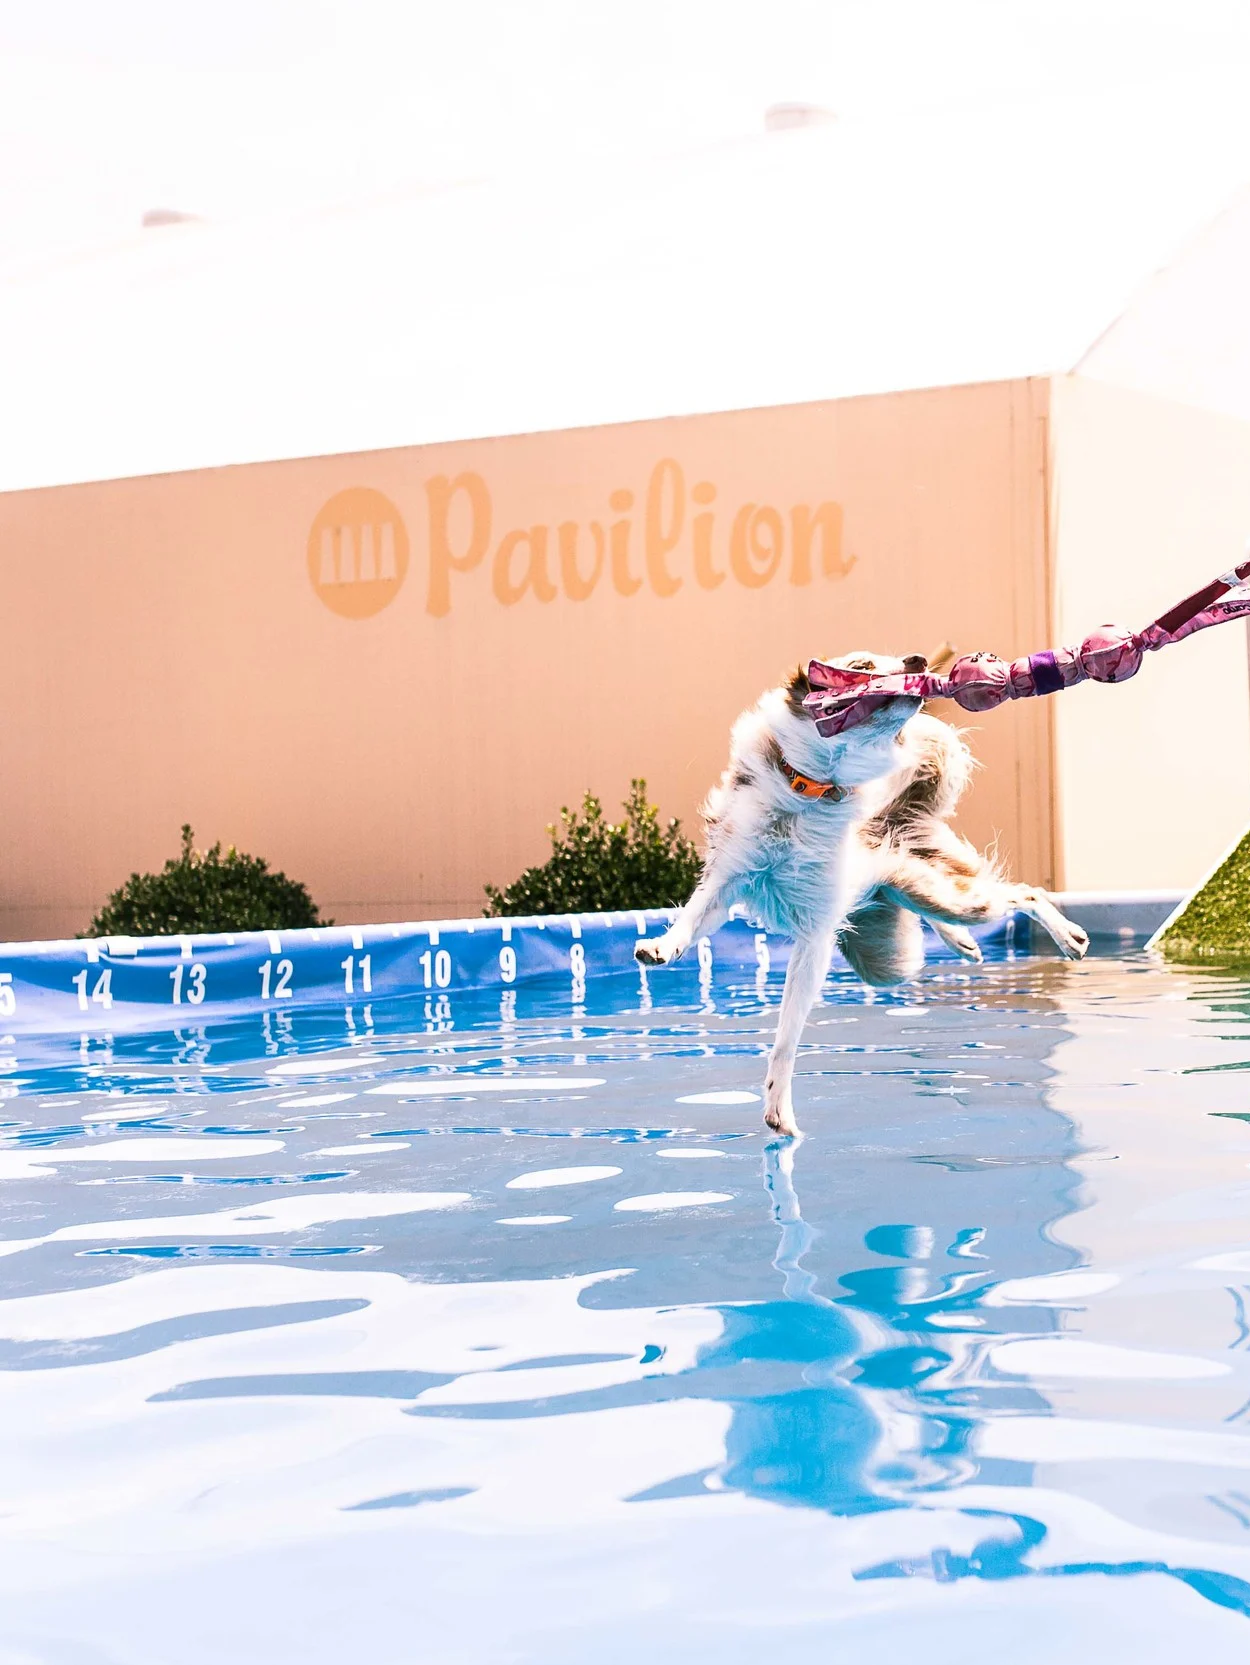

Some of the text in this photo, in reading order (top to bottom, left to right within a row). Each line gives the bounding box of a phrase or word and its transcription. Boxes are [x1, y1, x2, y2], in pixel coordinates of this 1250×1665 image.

[425, 457, 858, 618] Pavilion
[0, 933, 770, 1016] 5 14 13 12 11 10 9 8 6 5
